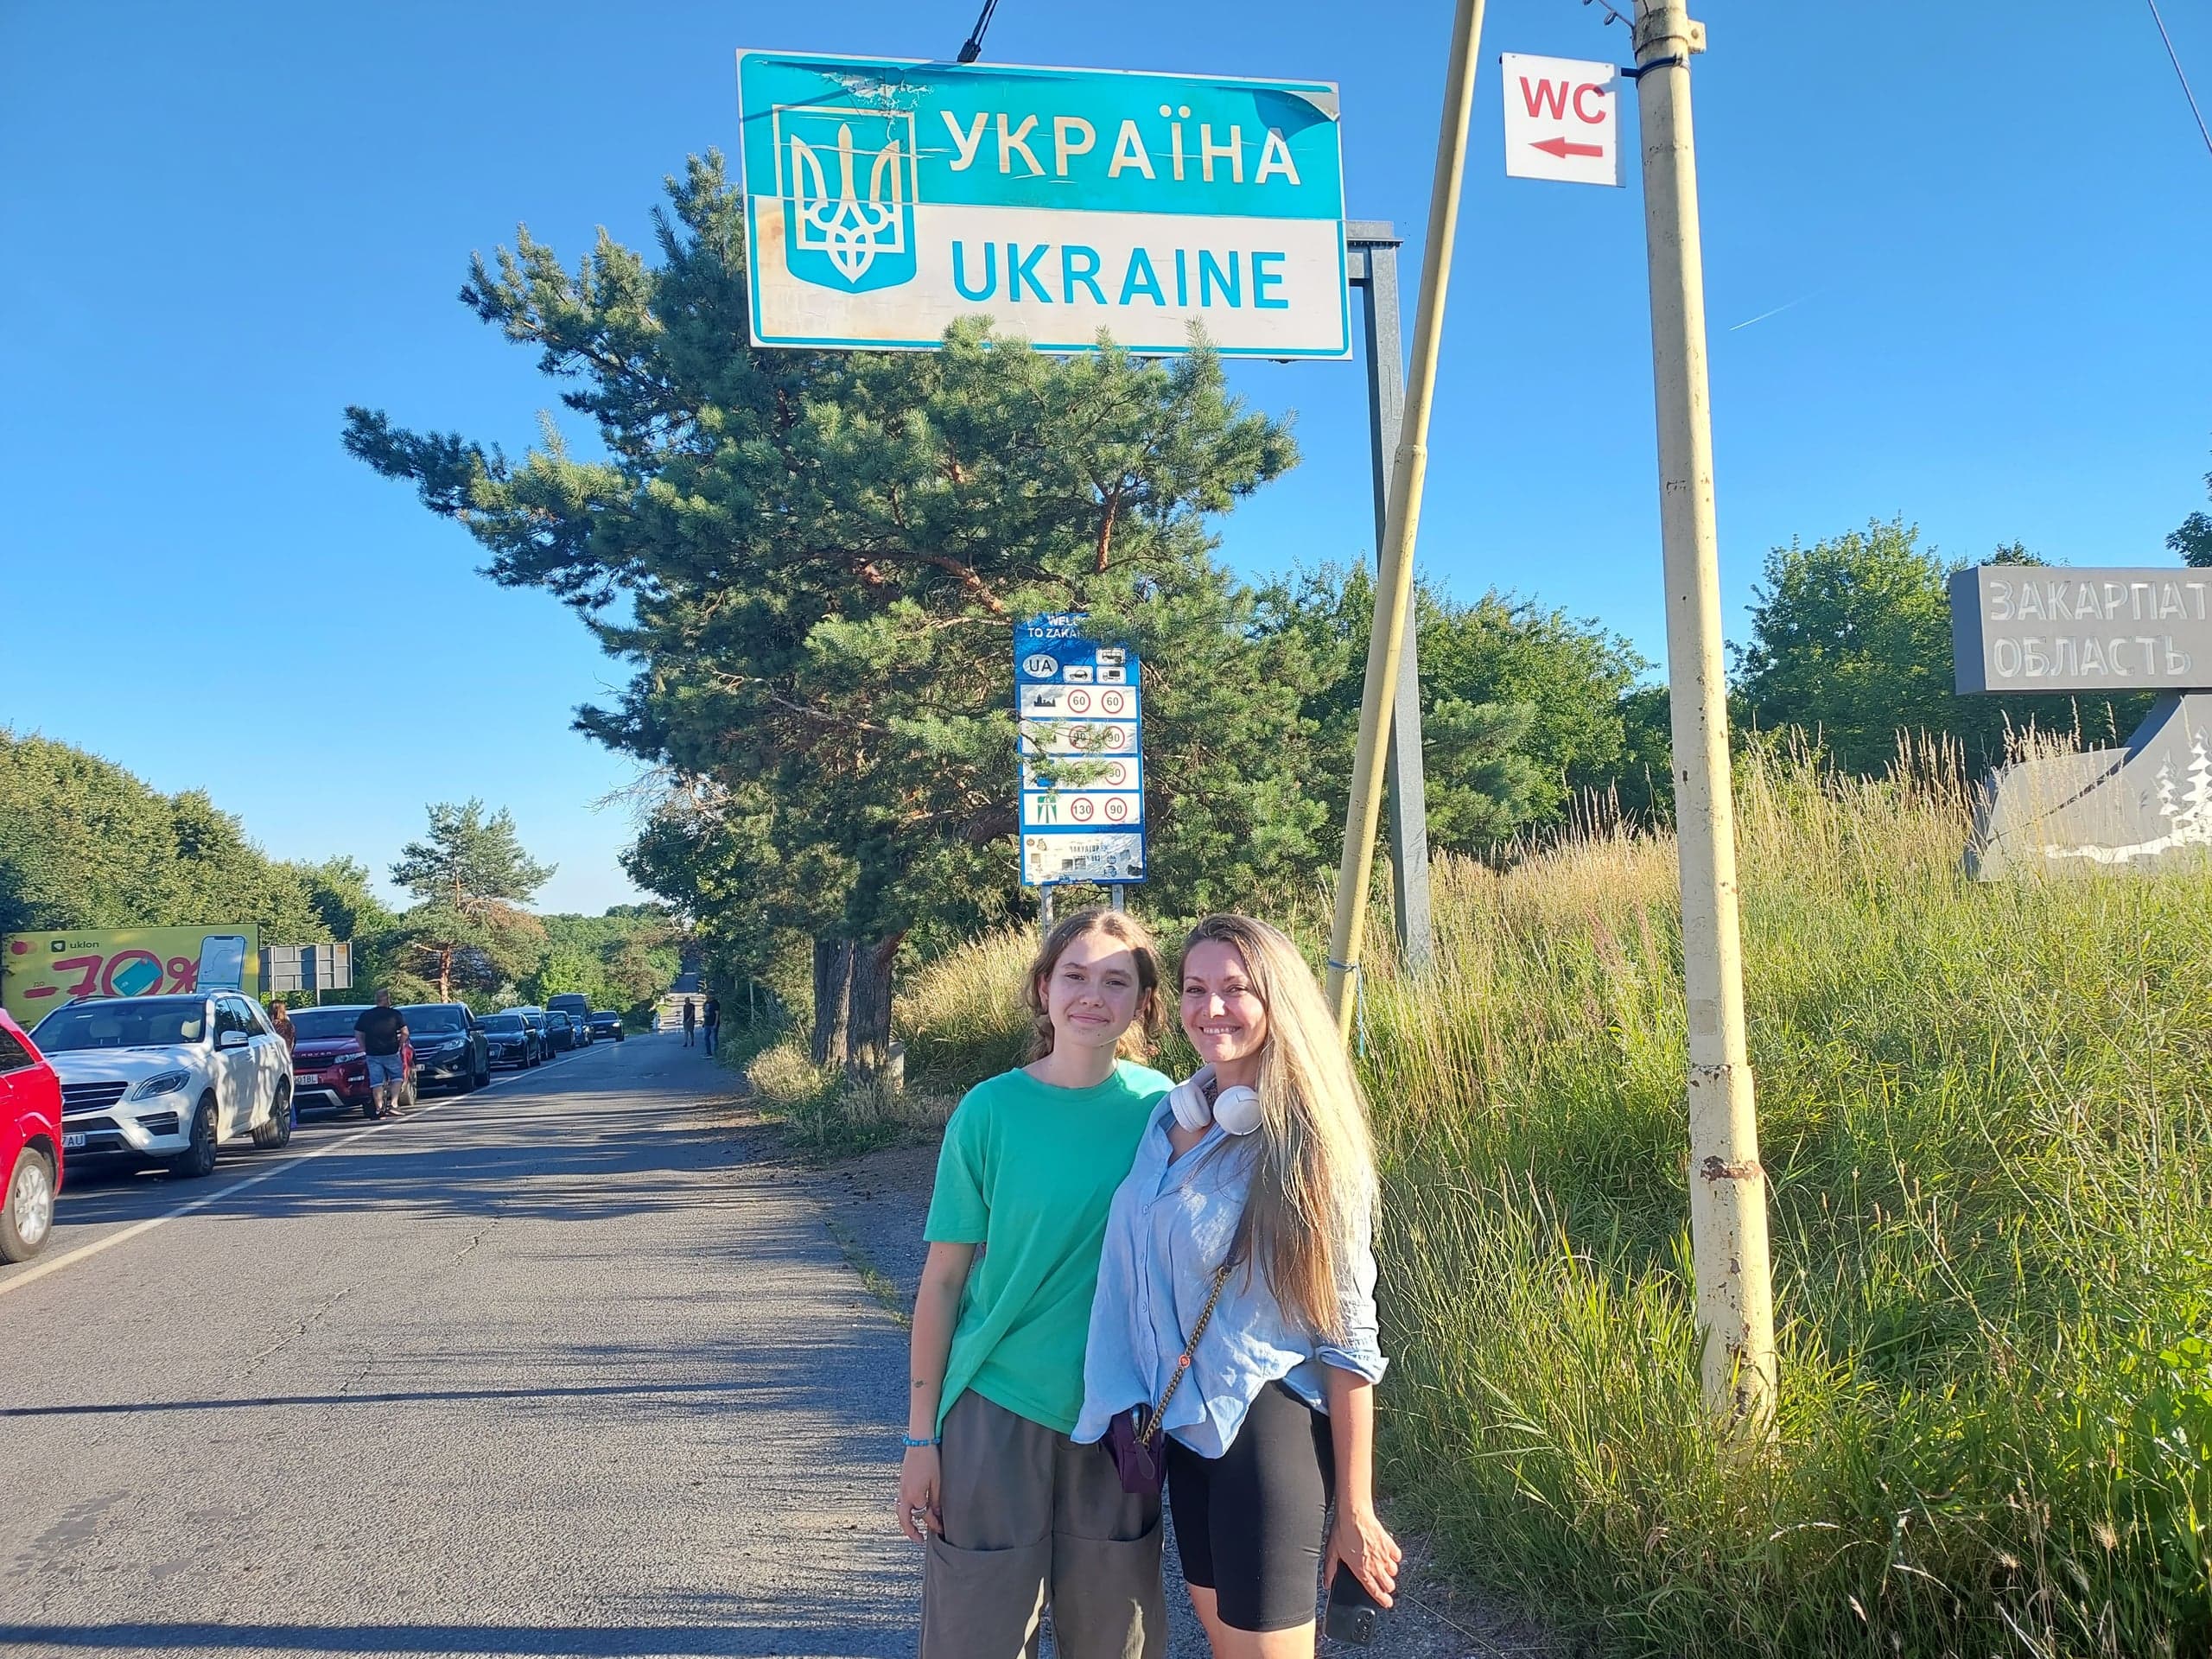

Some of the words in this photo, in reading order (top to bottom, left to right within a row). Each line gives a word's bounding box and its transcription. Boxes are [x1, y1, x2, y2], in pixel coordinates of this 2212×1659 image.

[1519, 76, 1606, 124] WC
[939, 105, 1300, 185] УКРАЇНА
[951, 240, 1289, 309] UKRAINE
[1990, 580, 2212, 621] ЗАКАРПАТ
[1027, 627, 1044, 638] TO
[1993, 635, 2192, 677] ОБЛАСТЬ
[1029, 659, 1052, 672] UA
[1073, 696, 1085, 706] 60
[1106, 696, 1119, 707] 60
[1108, 733, 1121, 743] 90
[1072, 804, 1091, 815] 130
[1109, 804, 1122, 815] 90
[70, 940, 99, 949] uklon
